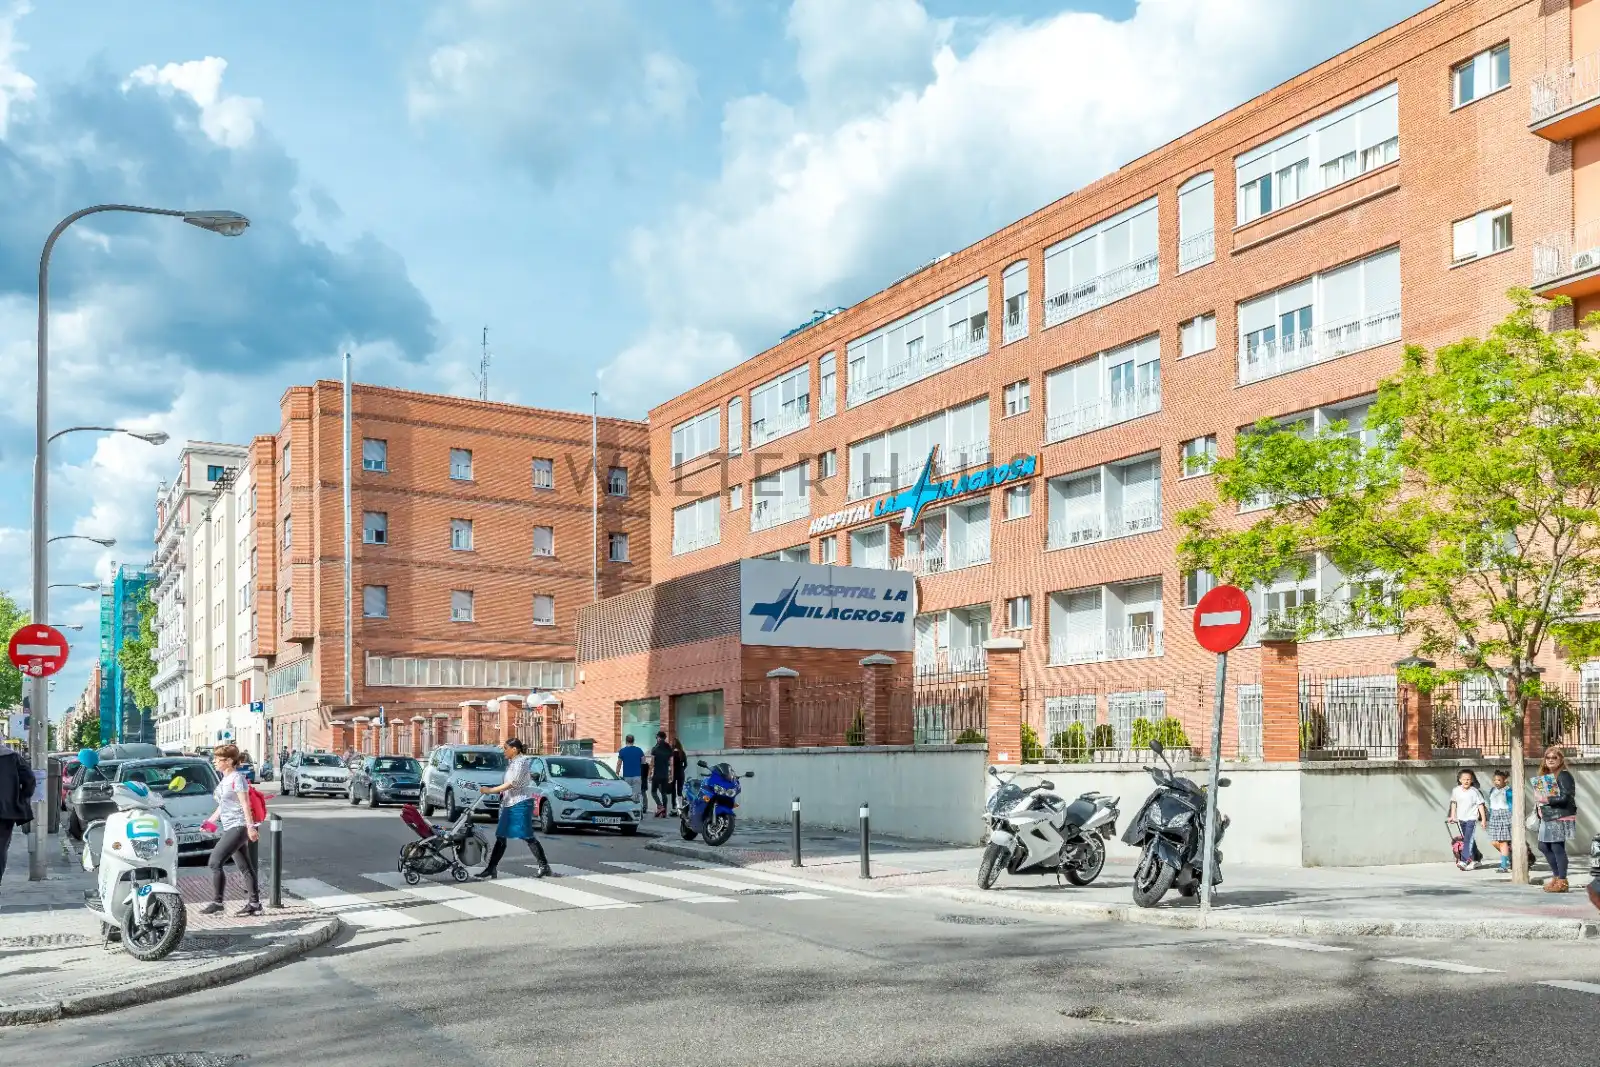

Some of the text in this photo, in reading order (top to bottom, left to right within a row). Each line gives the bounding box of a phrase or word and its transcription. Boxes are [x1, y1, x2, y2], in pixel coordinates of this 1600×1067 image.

[809, 503, 871, 536] HOSPITAL
[801, 583, 908, 602] HOSPITAL LA
